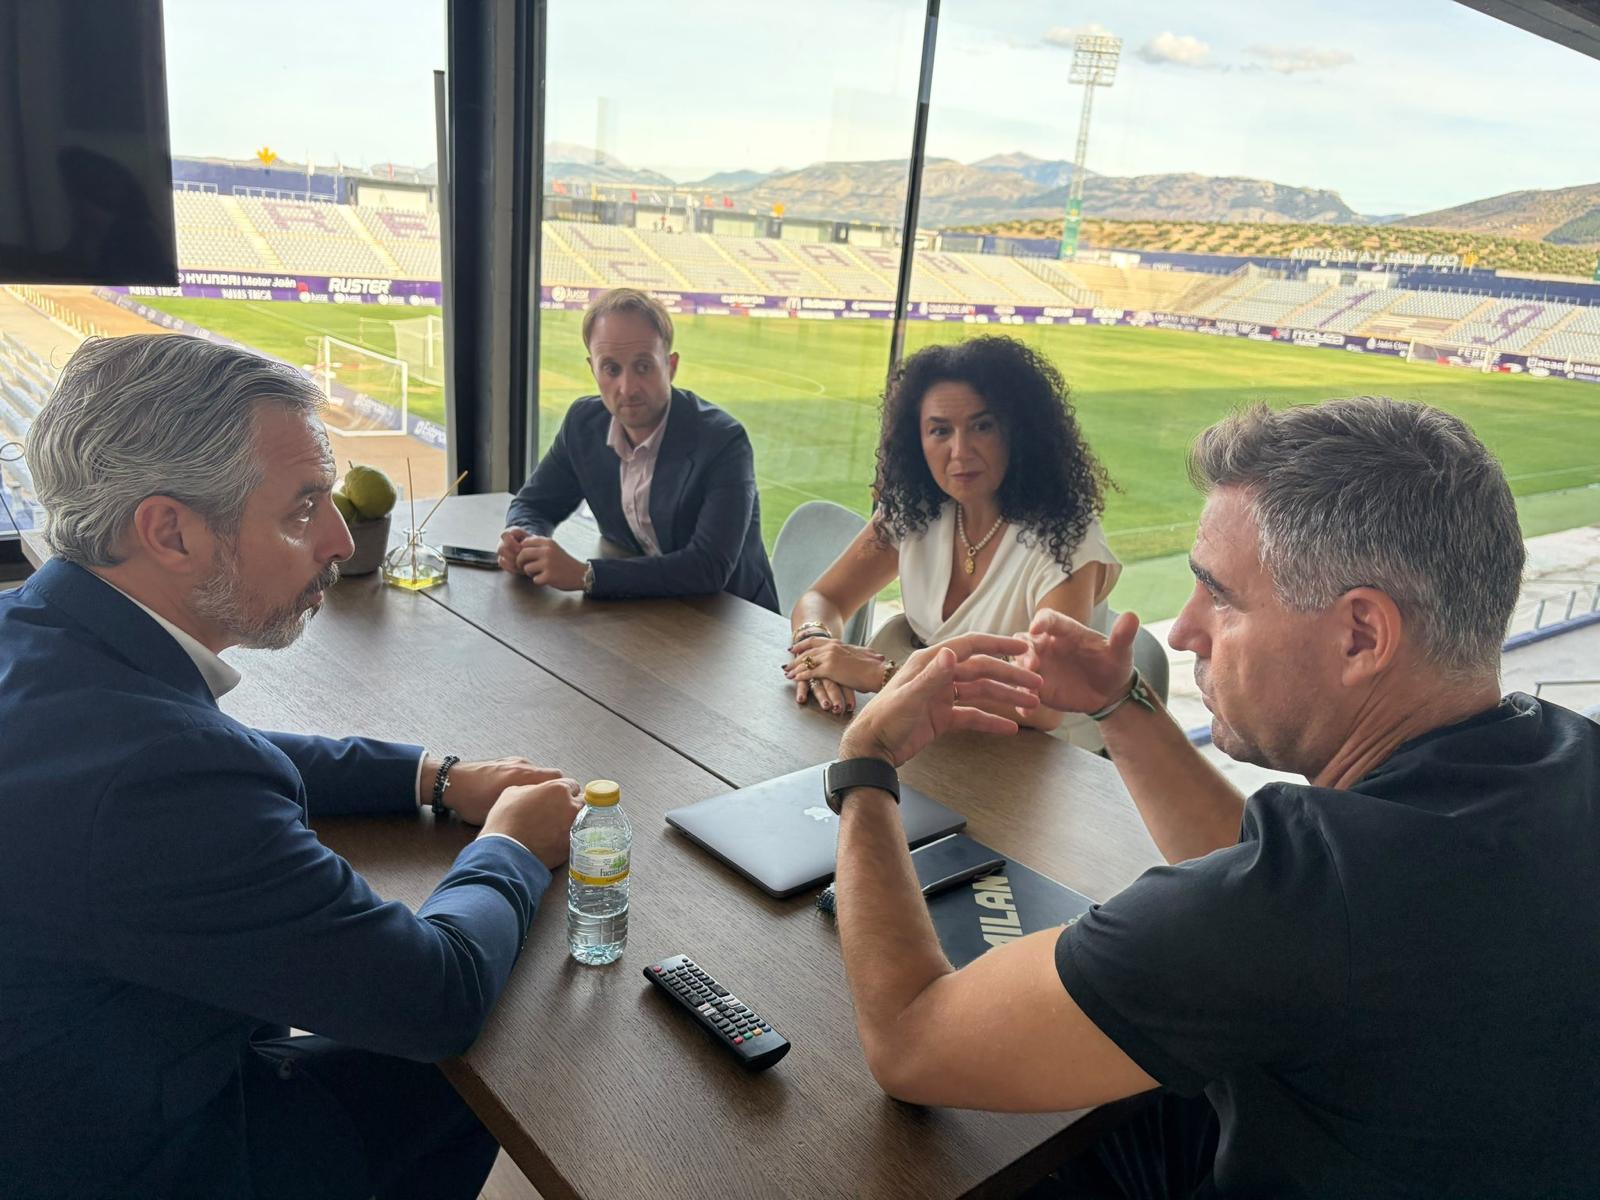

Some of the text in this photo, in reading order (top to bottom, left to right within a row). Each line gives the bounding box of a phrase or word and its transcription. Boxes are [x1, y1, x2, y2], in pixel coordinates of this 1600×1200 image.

[185, 273, 297, 289] HYUNDAI Motor Jaén
[328, 277, 392, 295] RUSTER
